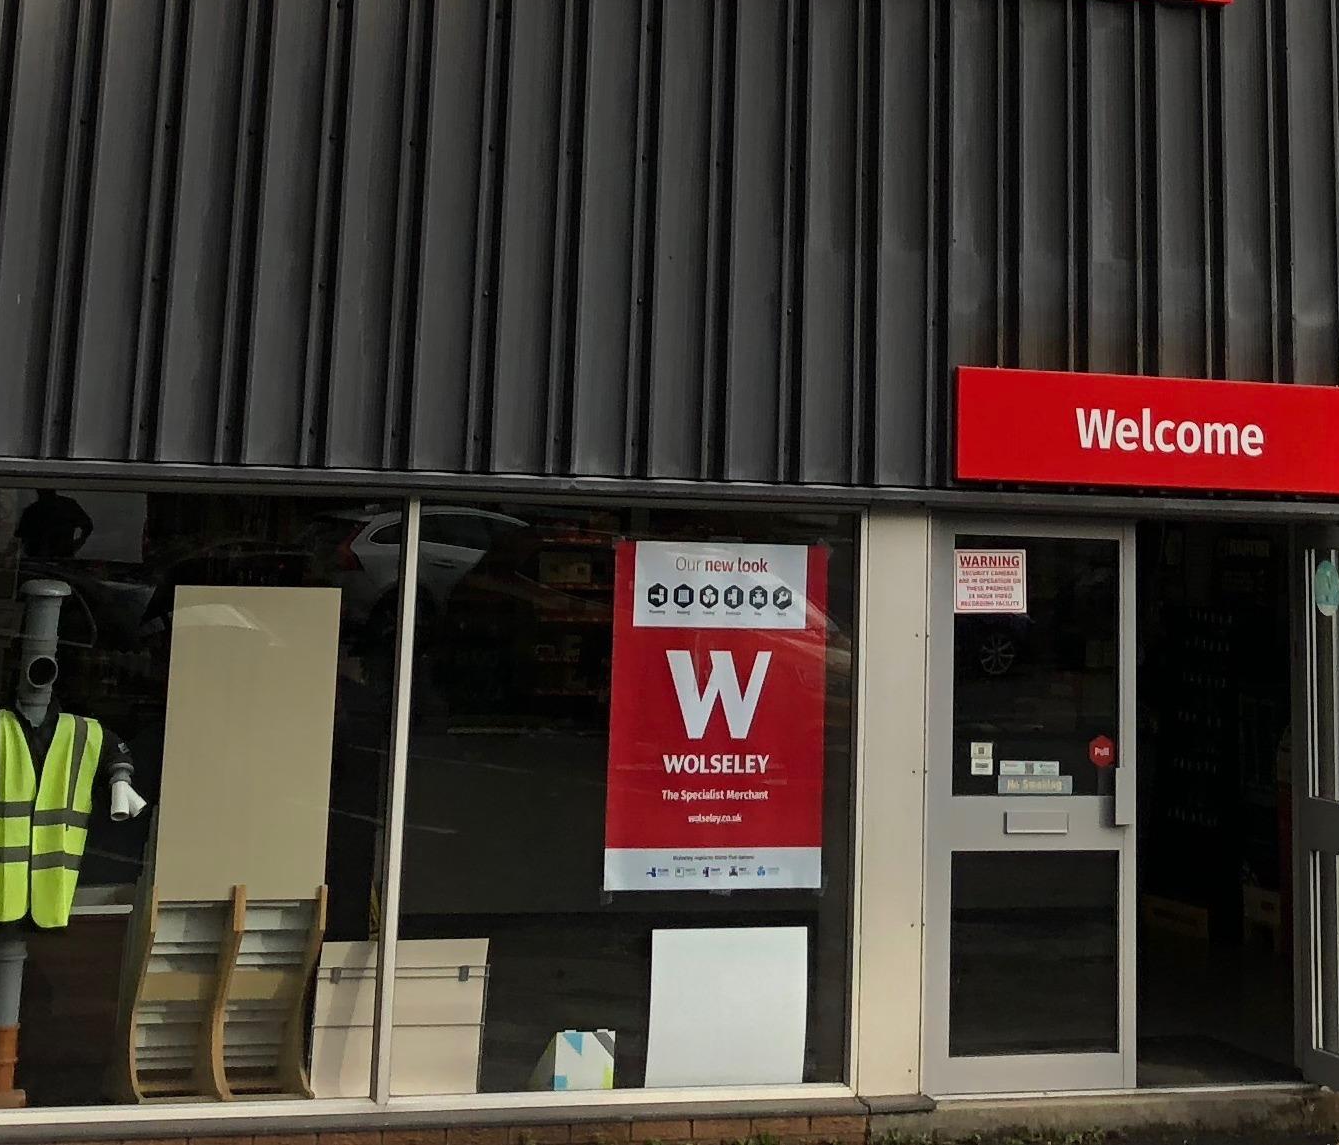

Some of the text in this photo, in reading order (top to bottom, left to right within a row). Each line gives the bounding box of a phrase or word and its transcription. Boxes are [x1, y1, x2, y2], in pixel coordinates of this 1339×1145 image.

[1076, 408, 1264, 457] Welcome
[675, 556, 768, 573] Our new look
[959, 555, 1020, 567] WARNING
[666, 650, 772, 739] W
[662, 754, 769, 774] WOLSELEY
[1007, 778, 1062, 792] No Smoking
[662, 789, 768, 802] The Specialist Merchant
[688, 813, 742, 824] wolseley.co.uk
